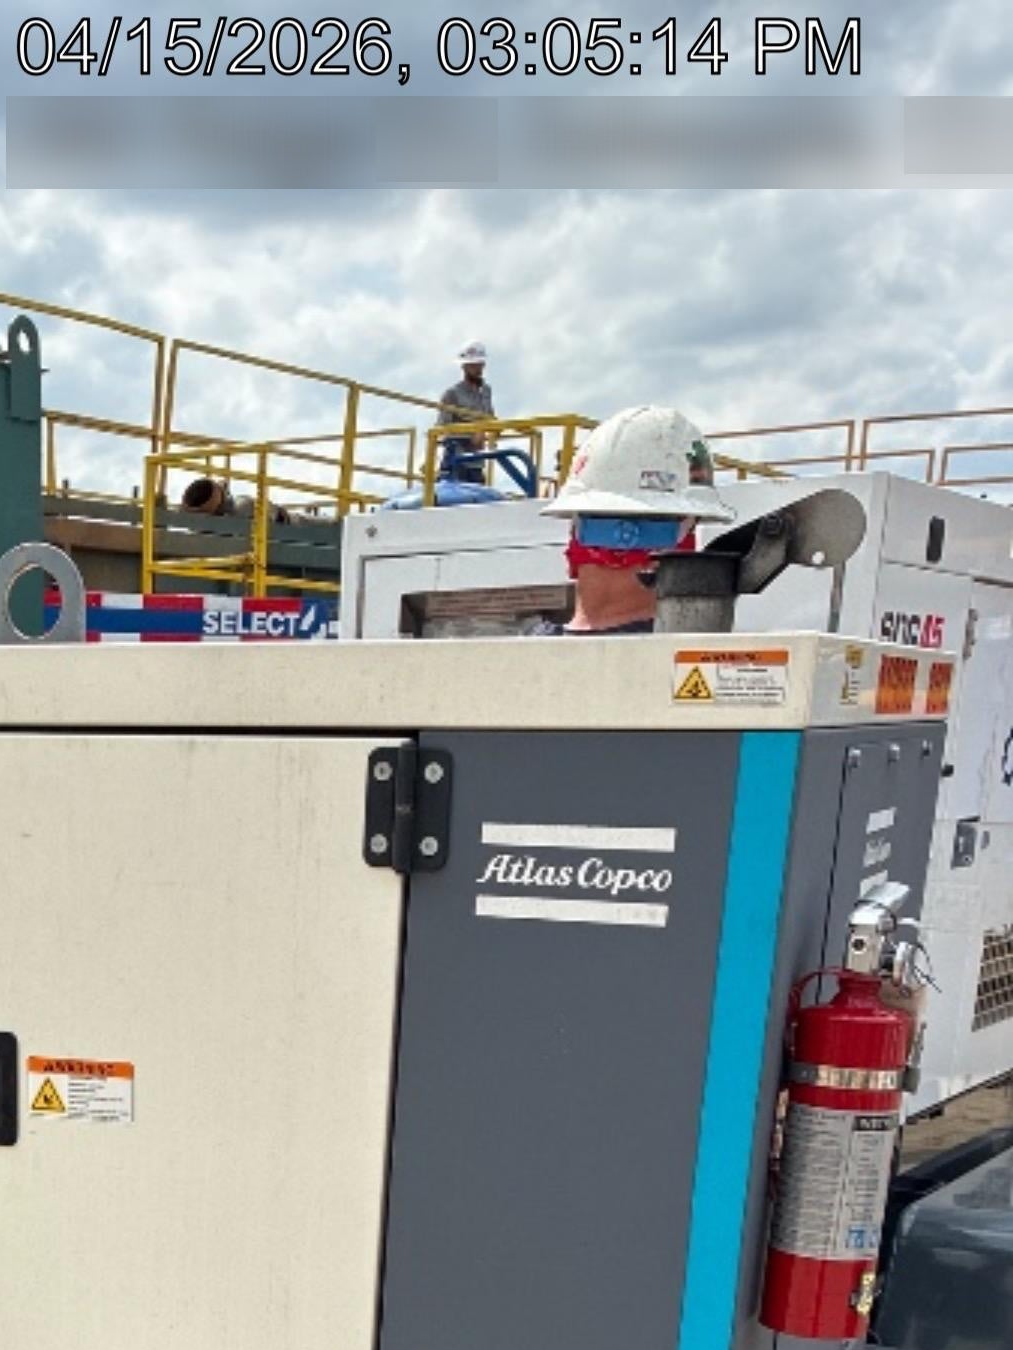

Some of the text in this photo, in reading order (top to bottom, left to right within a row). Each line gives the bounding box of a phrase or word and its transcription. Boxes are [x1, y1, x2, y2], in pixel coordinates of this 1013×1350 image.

[202, 611, 300, 636] SELECT
[476, 853, 673, 895] Atlas Copco
